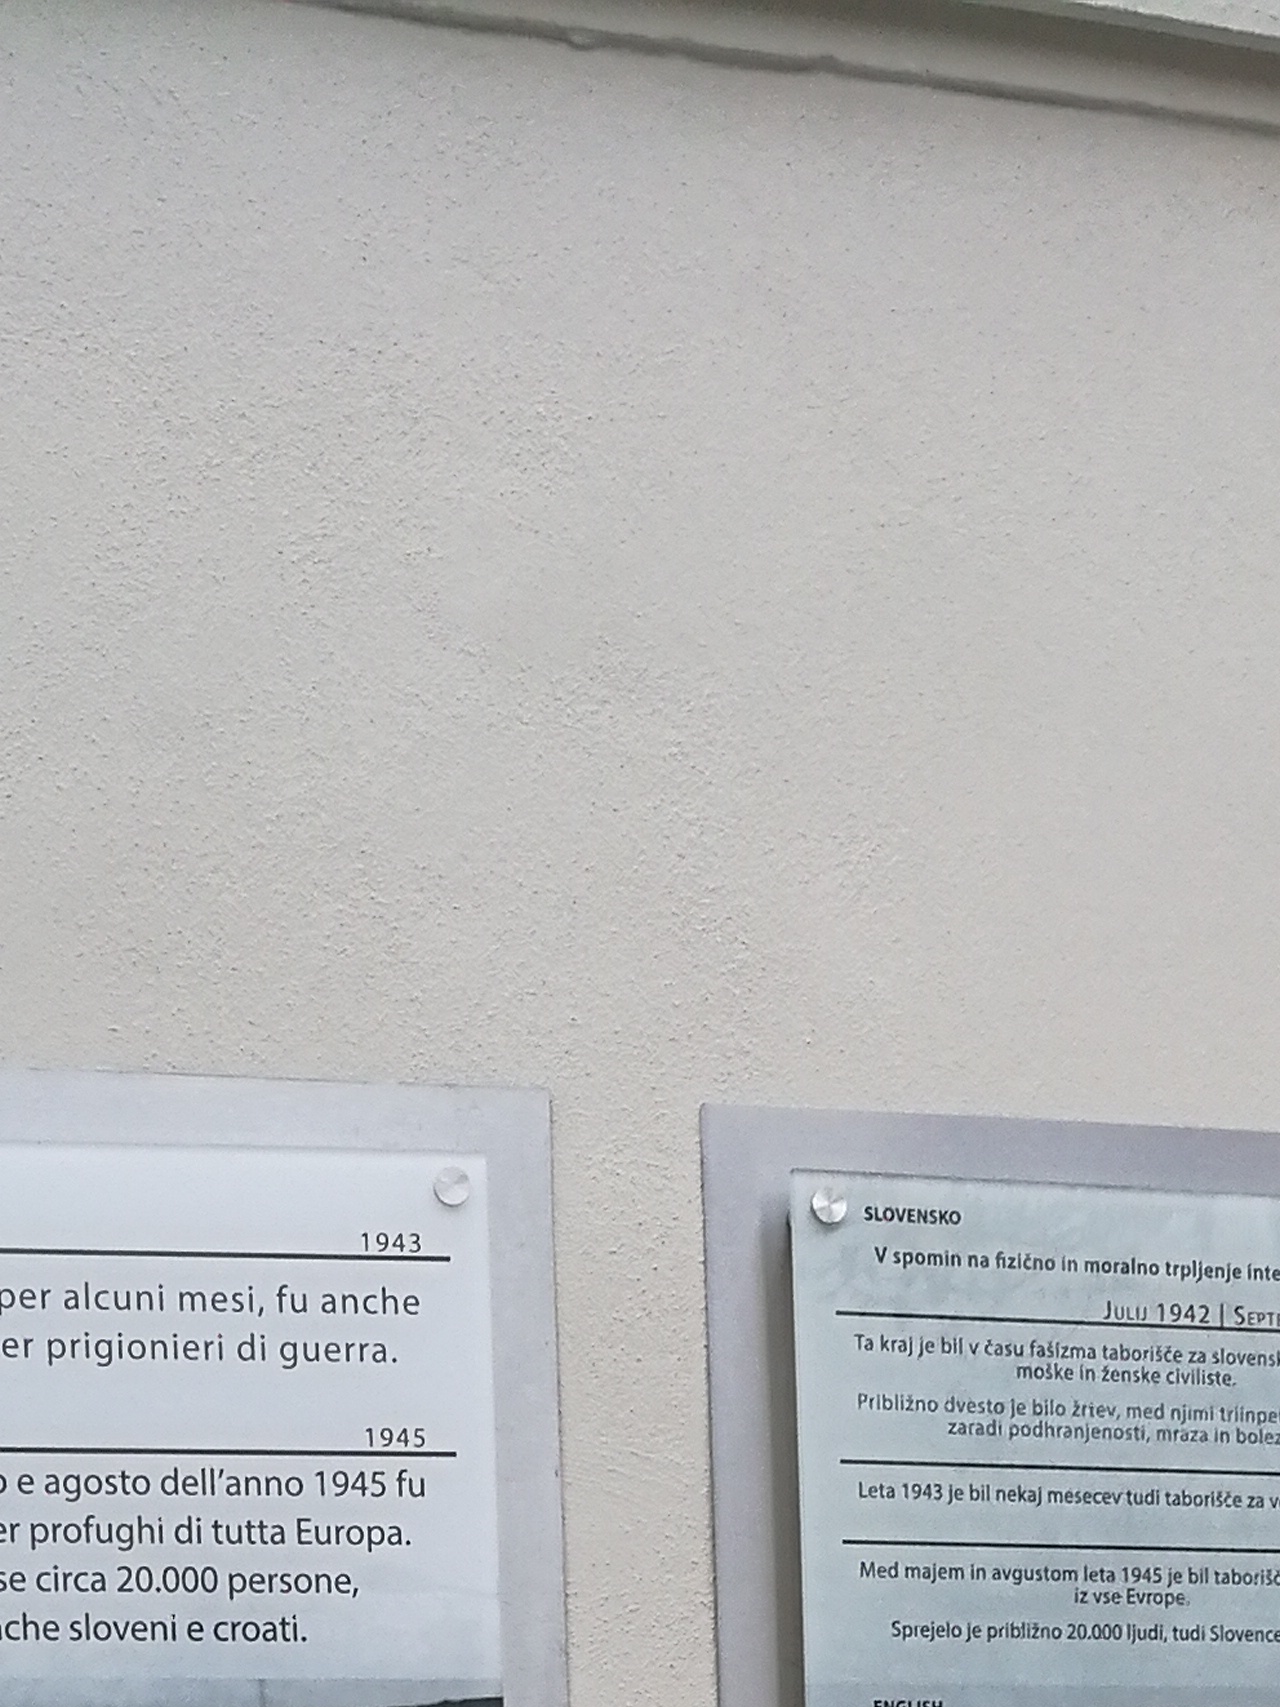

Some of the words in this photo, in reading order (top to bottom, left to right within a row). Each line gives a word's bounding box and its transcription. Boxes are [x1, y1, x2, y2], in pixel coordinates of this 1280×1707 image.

[863, 1205, 962, 1226] SLOVENSKO
[361, 1232, 422, 1253] 1943
[874, 1245, 888, 1264] V
[893, 1250, 962, 1270] spomin
[967, 1254, 990, 1269] na
[995, 1251, 1056, 1272] fizično
[1061, 1255, 1078, 1273] in
[1084, 1256, 1160, 1276] moralno
[1165, 1259, 1242, 1285] trpljenje
[63, 1281, 164, 1312] alcuni
[178, 1285, 264, 1318] mesi,
[276, 1284, 308, 1314] fu
[321, 1285, 420, 1316] anche
[47, 1331, 224, 1368] prigionieri
[237, 1332, 266, 1362] di
[279, 1341, 397, 1370] guerra.
[365, 1427, 426, 1449] 1945
[17, 1473, 35, 1495] e
[44, 1470, 151, 1503] agosto
[160, 1466, 304, 1498] dell'anno
[315, 1470, 387, 1498] 1945
[396, 1468, 426, 1498] fu
[30, 1514, 164, 1552] profughi
[174, 1515, 202, 1545] di
[211, 1519, 286, 1546] tutta
[296, 1517, 411, 1554] Europa.
[35, 1564, 107, 1593] circa
[116, 1565, 219, 1594] 20.000
[228, 1572, 359, 1601] persone,
[69, 1612, 177, 1642] sloveni
[186, 1620, 205, 1642] e
[213, 1613, 307, 1642] croati.
